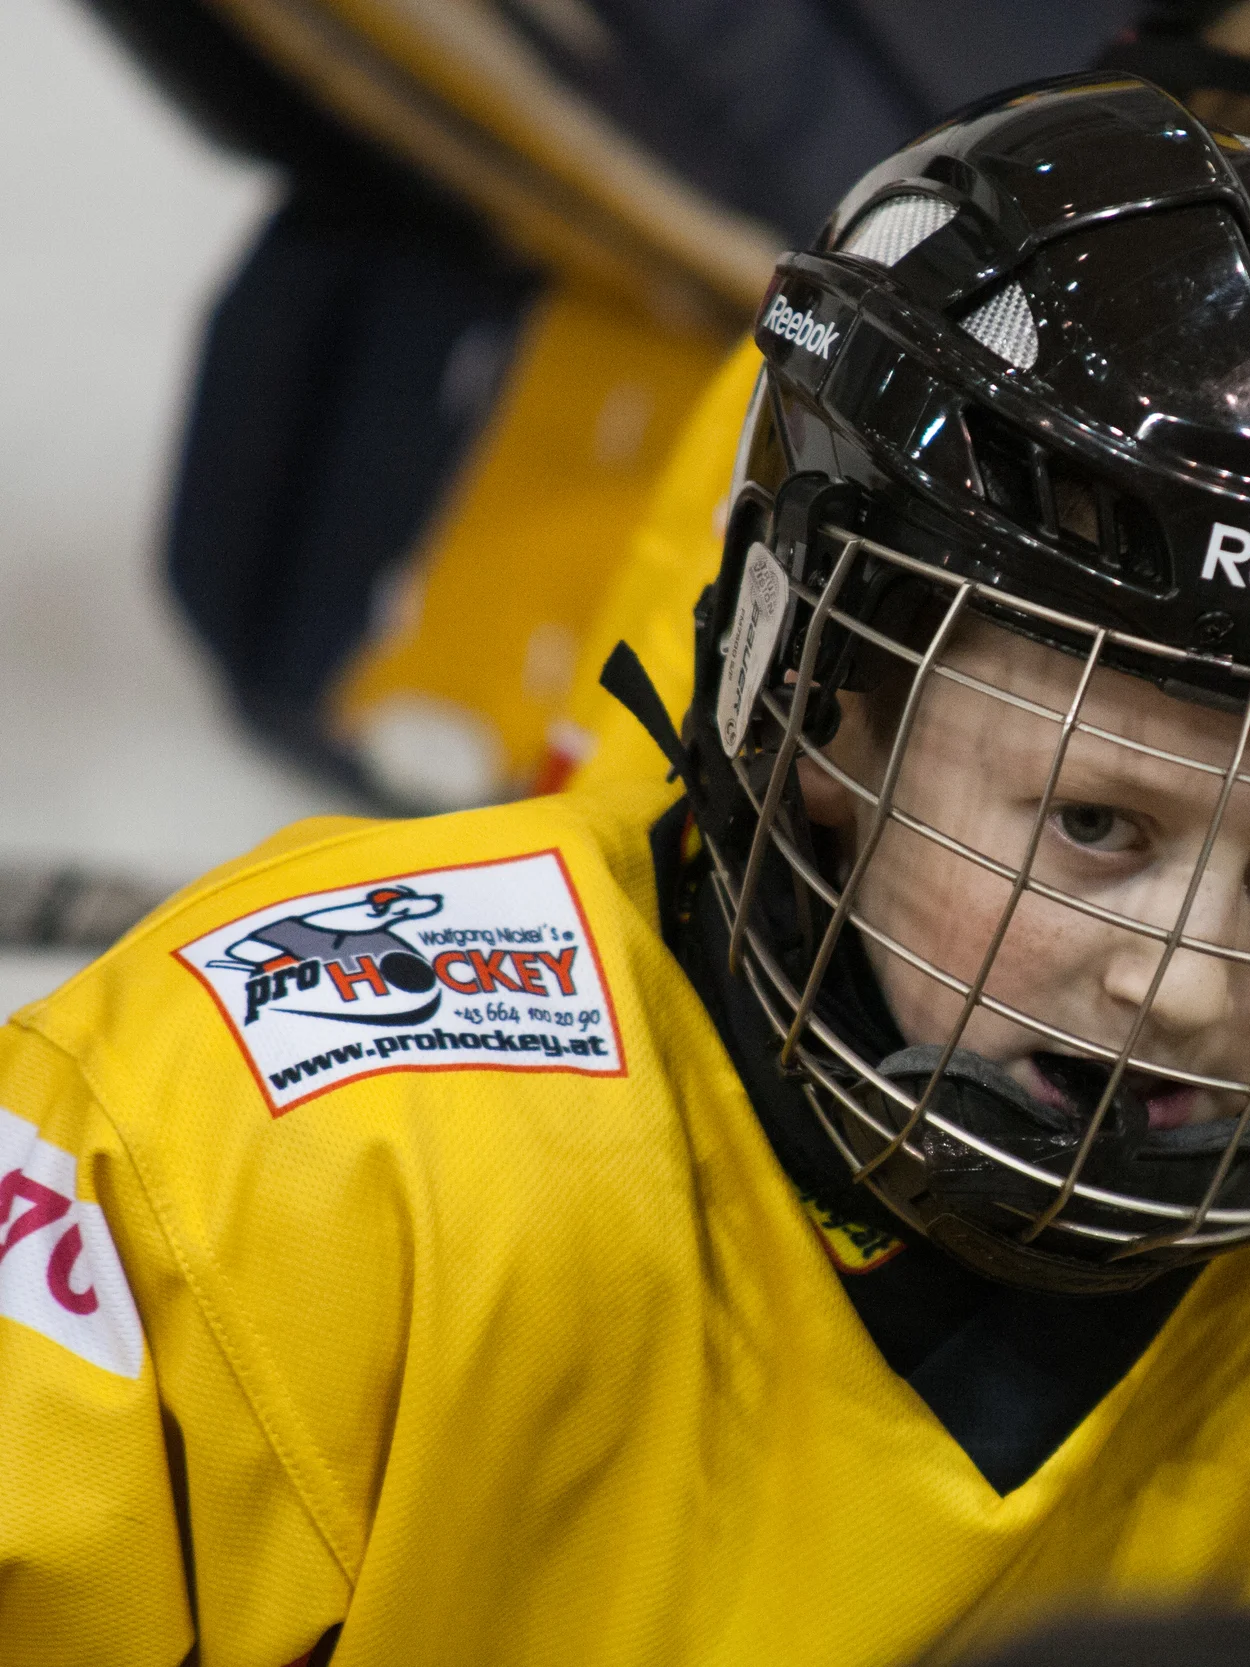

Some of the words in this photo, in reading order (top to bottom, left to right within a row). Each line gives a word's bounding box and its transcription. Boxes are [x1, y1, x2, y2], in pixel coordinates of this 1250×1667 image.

[763, 294, 840, 360] Reebok
[418, 928, 496, 946] Wolfgang
[244, 959, 321, 1027] pro
[325, 945, 579, 1002] HOCKEY
[454, 1007, 484, 1025] +43
[486, 1002, 520, 1024] 664
[528, 1007, 550, 1022] 100
[554, 1011, 574, 1026] 20
[578, 1009, 601, 1032] 90
[269, 1028, 609, 1091] www.prohockey.at
